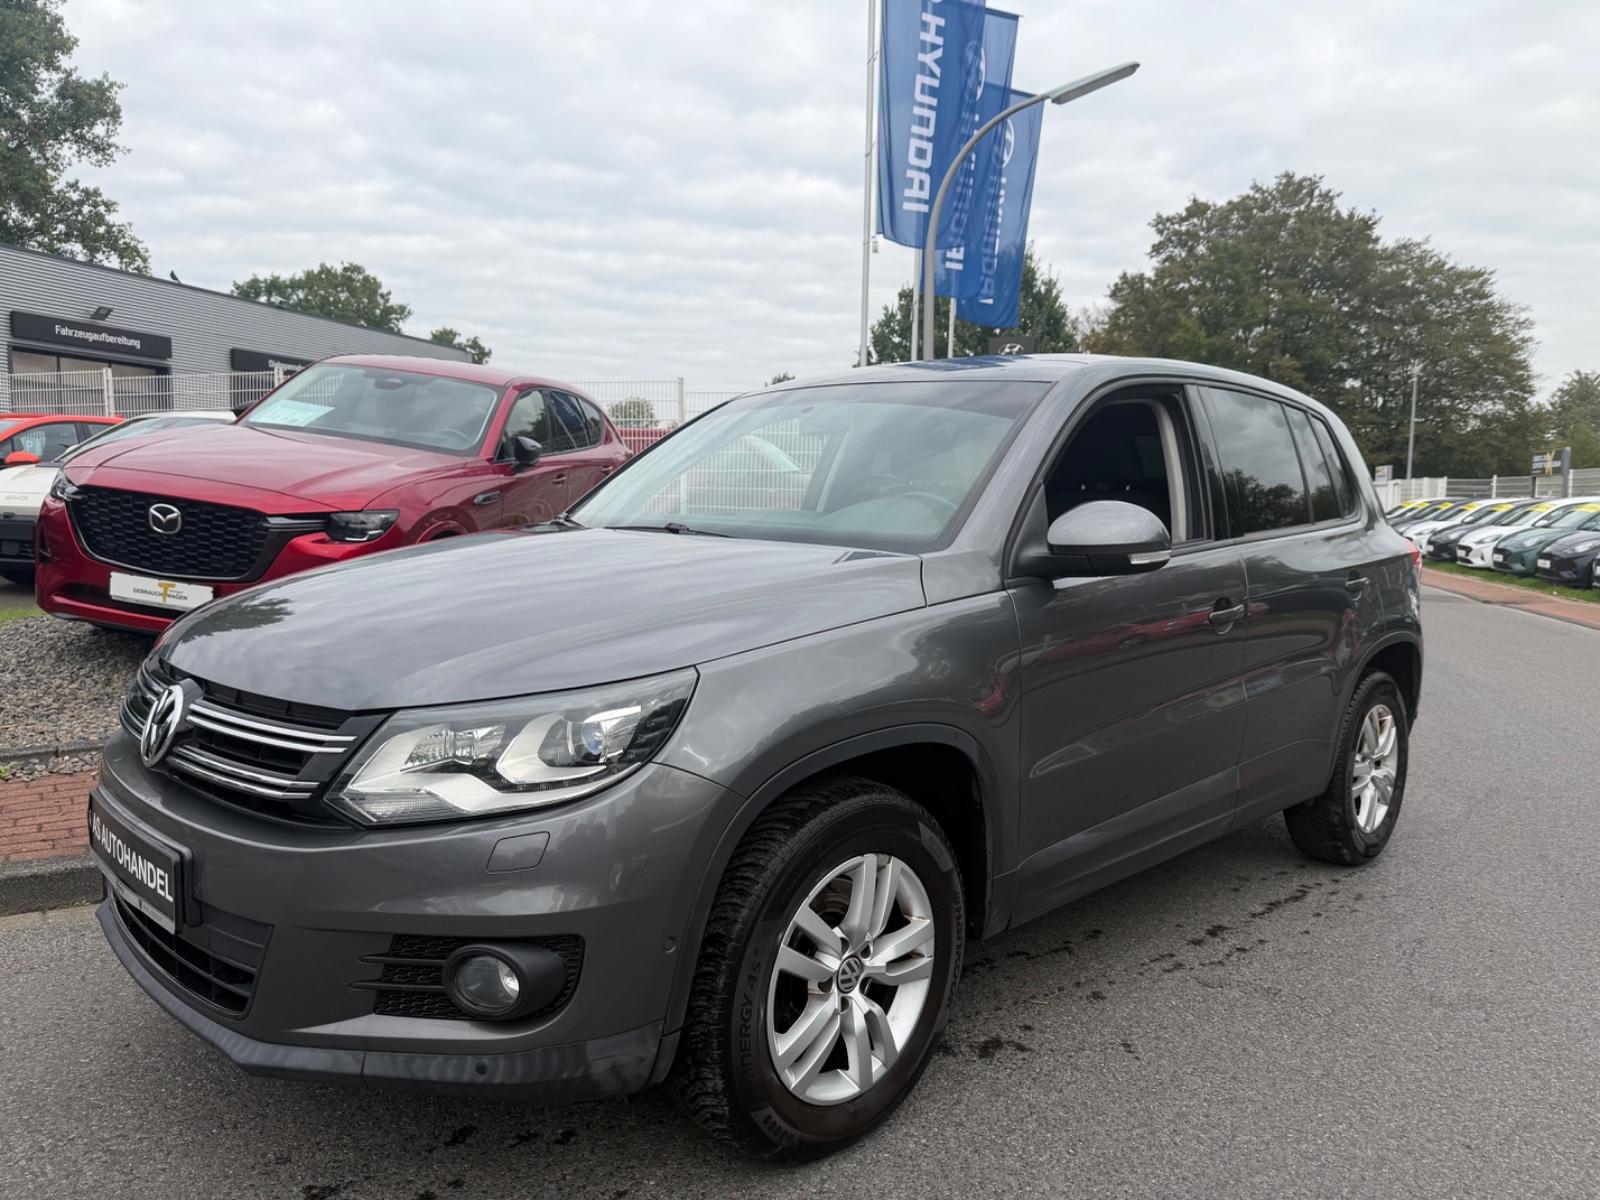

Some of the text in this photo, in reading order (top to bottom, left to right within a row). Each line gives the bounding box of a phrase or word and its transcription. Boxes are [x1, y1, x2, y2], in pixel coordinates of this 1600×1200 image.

[902, 12, 946, 213] HYUNDAI
[55, 325, 141, 349] Fahrzeugaufbereitung
[92, 812, 174, 903] AS AUTOHANDEL
